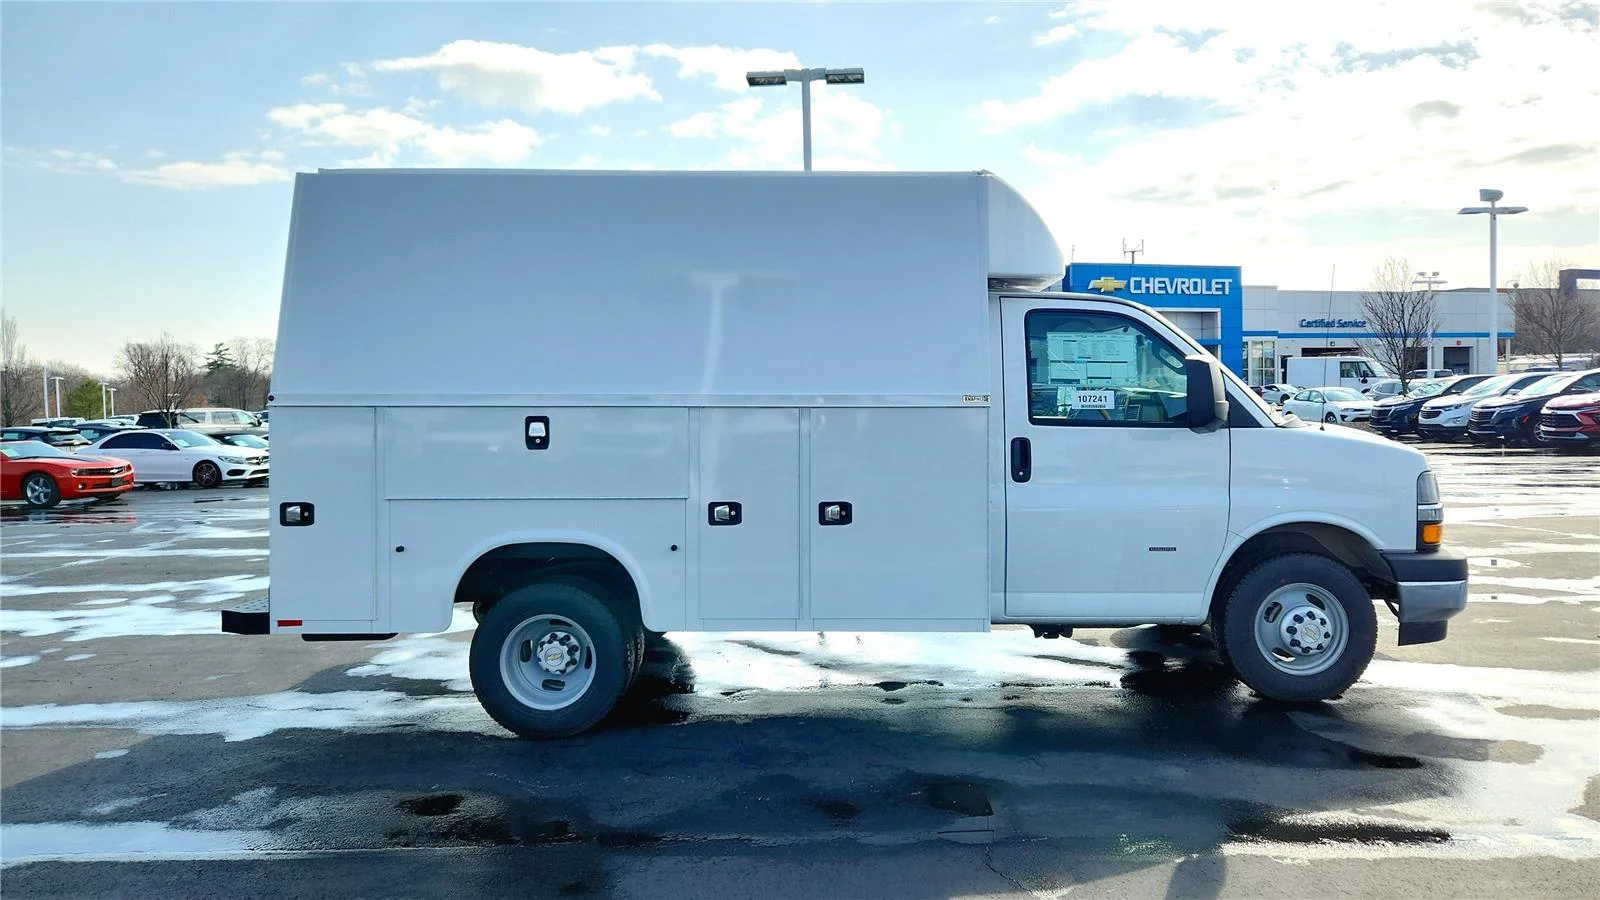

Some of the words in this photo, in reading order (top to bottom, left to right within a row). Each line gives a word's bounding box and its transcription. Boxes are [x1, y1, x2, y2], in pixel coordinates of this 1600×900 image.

[1129, 276, 1232, 295] CHEVROLET
[1300, 318, 1335, 328] Certified
[1337, 319, 1366, 328] Service
[1078, 395, 1107, 403] 107241
